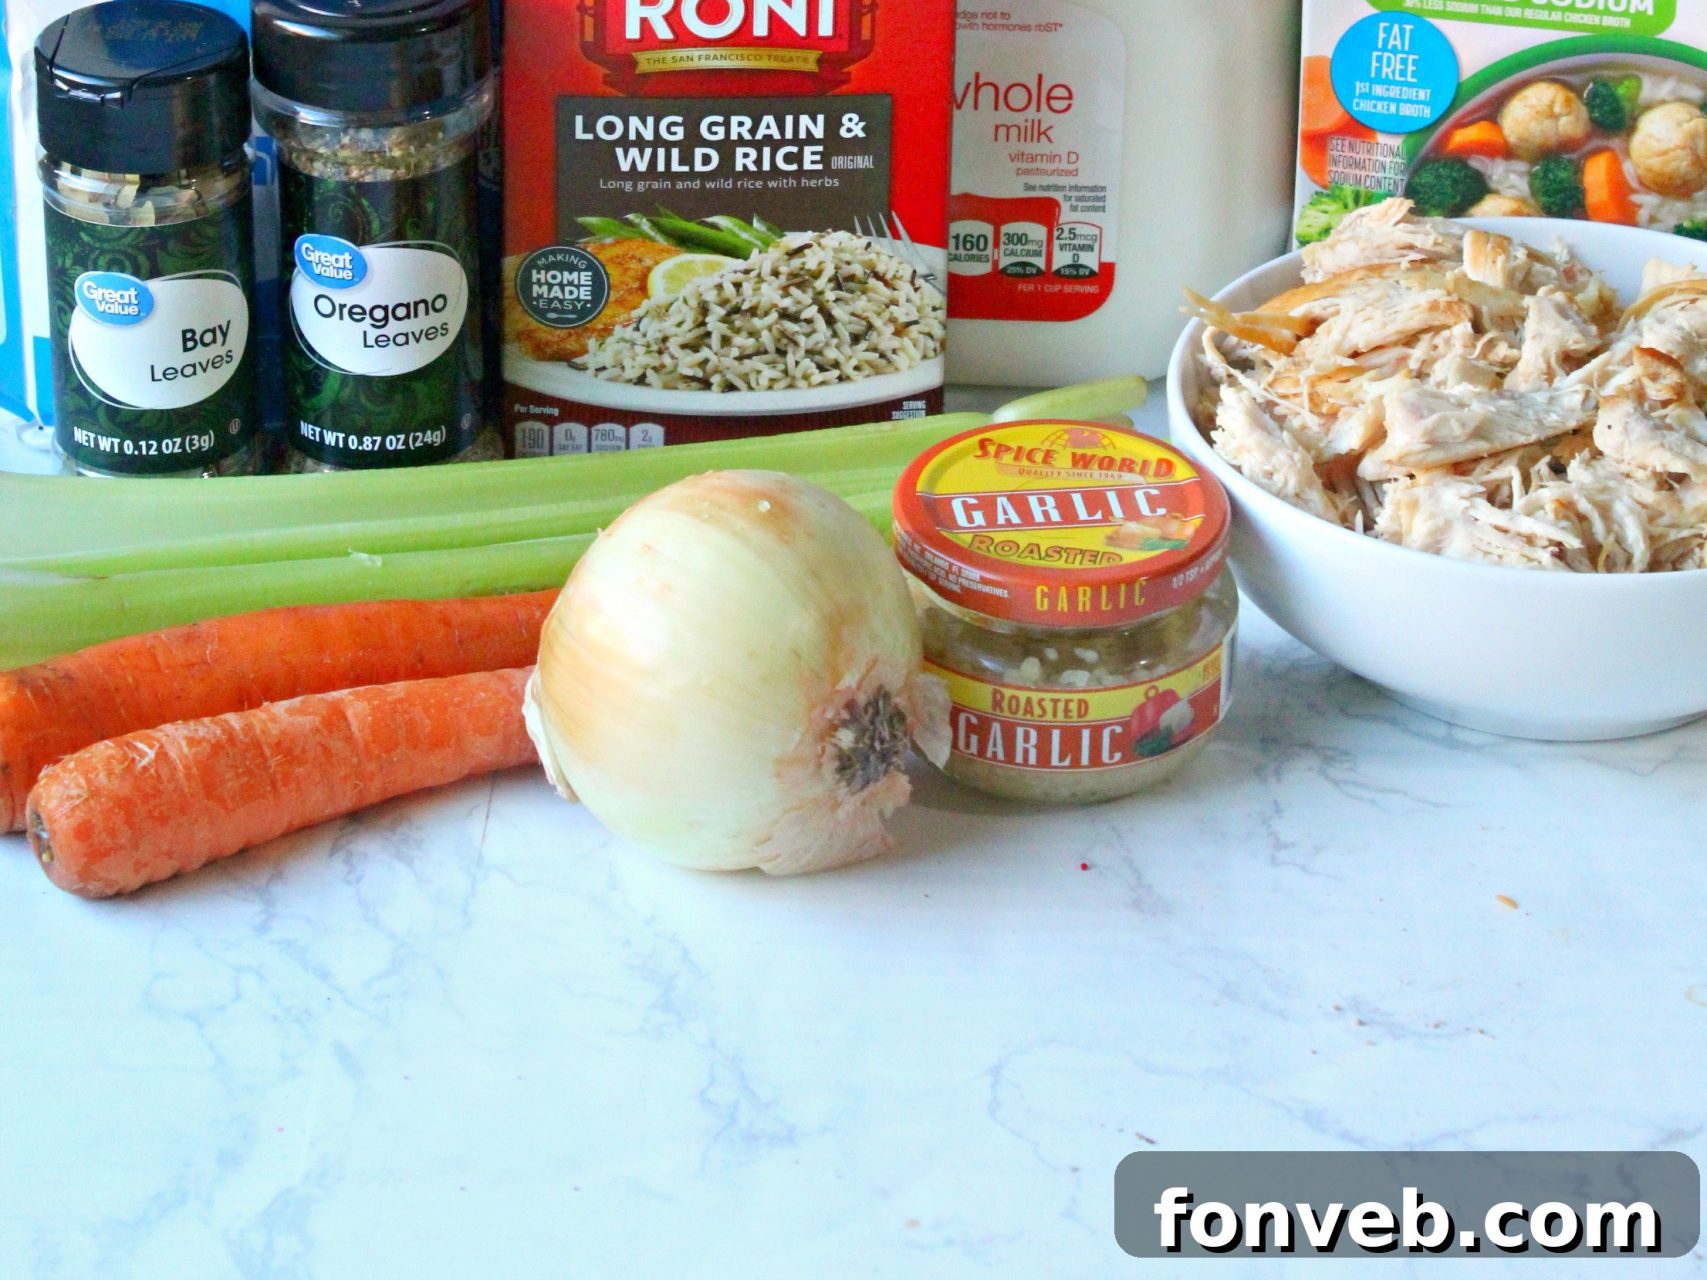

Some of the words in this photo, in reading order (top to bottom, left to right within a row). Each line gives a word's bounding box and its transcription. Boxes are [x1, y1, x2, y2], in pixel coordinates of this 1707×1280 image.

[1424, 0, 1444, 10] LESS
[1446, 1, 1478, 13] SODIUM
[1480, 4, 1503, 15] THAN
[1505, 7, 1522, 17] OUR
[1524, 9, 1562, 22] REGULAR
[1565, 13, 1600, 25] CHICKEN
[1602, 16, 1631, 28] BROTH
[982, 22, 1031, 31] hormones
[1379, 23, 1414, 51] FAT
[646, 56, 667, 65] THE
[671, 55, 693, 63] SAN
[698, 53, 761, 62] FRANCISCO
[1370, 51, 1419, 82] FREE
[1372, 83, 1431, 101] INGREDIENT
[1353, 99, 1397, 114] CHICKEN
[1399, 102, 1430, 118] BROTH
[575, 115, 684, 140] LONG
[700, 114, 824, 140] GRAIN
[839, 112, 866, 138] &
[994, 119, 1053, 143] milk
[616, 147, 719, 172] WILD
[735, 146, 823, 171] RICE
[831, 156, 874, 168] ORIGINAL
[1009, 152, 1061, 163] vitamin
[1068, 152, 1079, 164] D
[1330, 137, 1347, 152] SEE
[1348, 140, 1405, 159] NUTRITIONAL
[1016, 168, 1078, 177] pasteurized
[1328, 153, 1386, 174] INFORMATION
[1389, 160, 1405, 176] FOR
[600, 178, 633, 190] Long
[637, 178, 671, 190] grain
[676, 178, 700, 188] and
[705, 178, 733, 188] wild
[739, 177, 762, 188] rice
[767, 177, 797, 187] with
[802, 176, 839, 187] herbs
[1024, 183, 1036, 191] See
[1069, 184, 1106, 192] information
[1328, 170, 1362, 187] SODIUM
[1364, 176, 1405, 193] CONTENT
[1064, 194, 1072, 202] for
[1080, 204, 1106, 212] content
[952, 234, 988, 251] 160
[1004, 248, 1042, 257] CALCIUM
[301, 243, 352, 270] Great
[537, 253, 588, 269] MAKING
[949, 253, 989, 263] CALORIES
[1073, 254, 1079, 262] D
[313, 262, 353, 281] Value
[532, 270, 592, 285] HOME
[82, 282, 139, 305] Great
[532, 285, 592, 299] MADE
[95, 300, 139, 317] Value
[314, 294, 448, 327] Oregano
[539, 299, 584, 309] EASY
[181, 320, 231, 353] Bay
[363, 322, 449, 350] Leaves
[150, 350, 234, 382] Leaves
[529, 405, 558, 416] Serving
[74, 427, 95, 449] NET
[98, 435, 120, 453] WT
[123, 439, 157, 455] 0.12
[162, 437, 182, 453] OZ
[185, 430, 215, 454] (3g)
[300, 420, 320, 442] NET
[324, 428, 346, 447] WT
[348, 435, 382, 451] 0.87
[386, 434, 405, 450] OZ
[409, 426, 446, 449] (24g)
[523, 428, 544, 449] 190
[974, 438, 1057, 468] SPICE
[1071, 450, 1177, 479] WORLD
[950, 489, 1167, 528] GARLIC
[968, 534, 1123, 564] ROASTED
[1036, 579, 1147, 612] GARLIC
[992, 689, 1088, 720] ROASTED
[958, 712, 1123, 767] GARLIC
